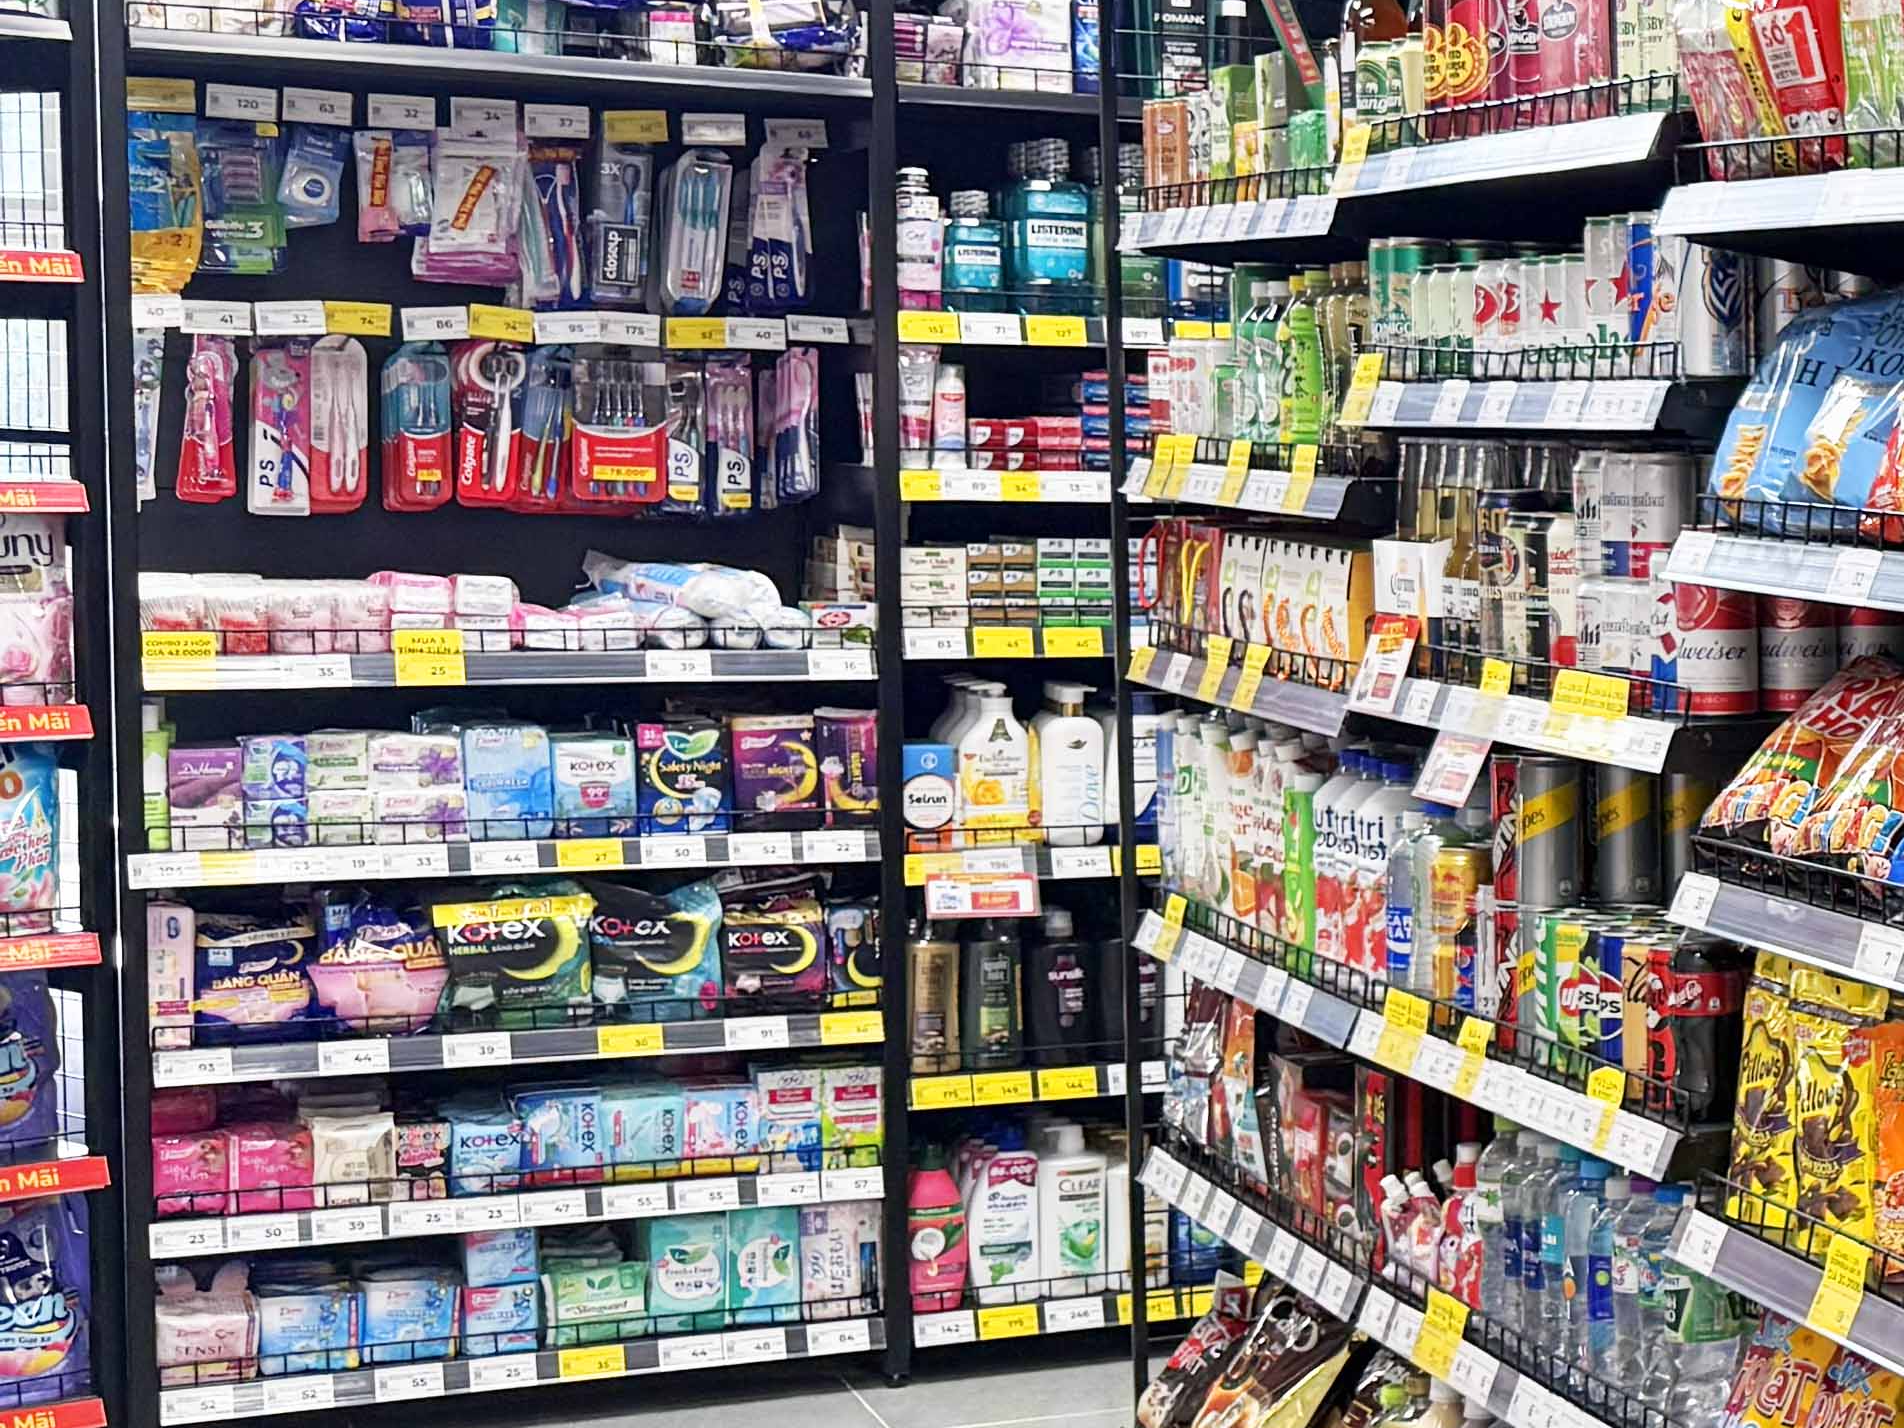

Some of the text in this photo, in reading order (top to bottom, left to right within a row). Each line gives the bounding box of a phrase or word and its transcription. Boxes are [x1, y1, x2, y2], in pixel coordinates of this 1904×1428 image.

[236, 98, 258, 110] 120
[1030, 222, 1086, 240] LISTERINE
[956, 247, 1000, 262] LISTERINE
[32, 256, 72, 275] Mãi
[461, 434, 476, 486] Colgate
[258, 458, 273, 488] PS
